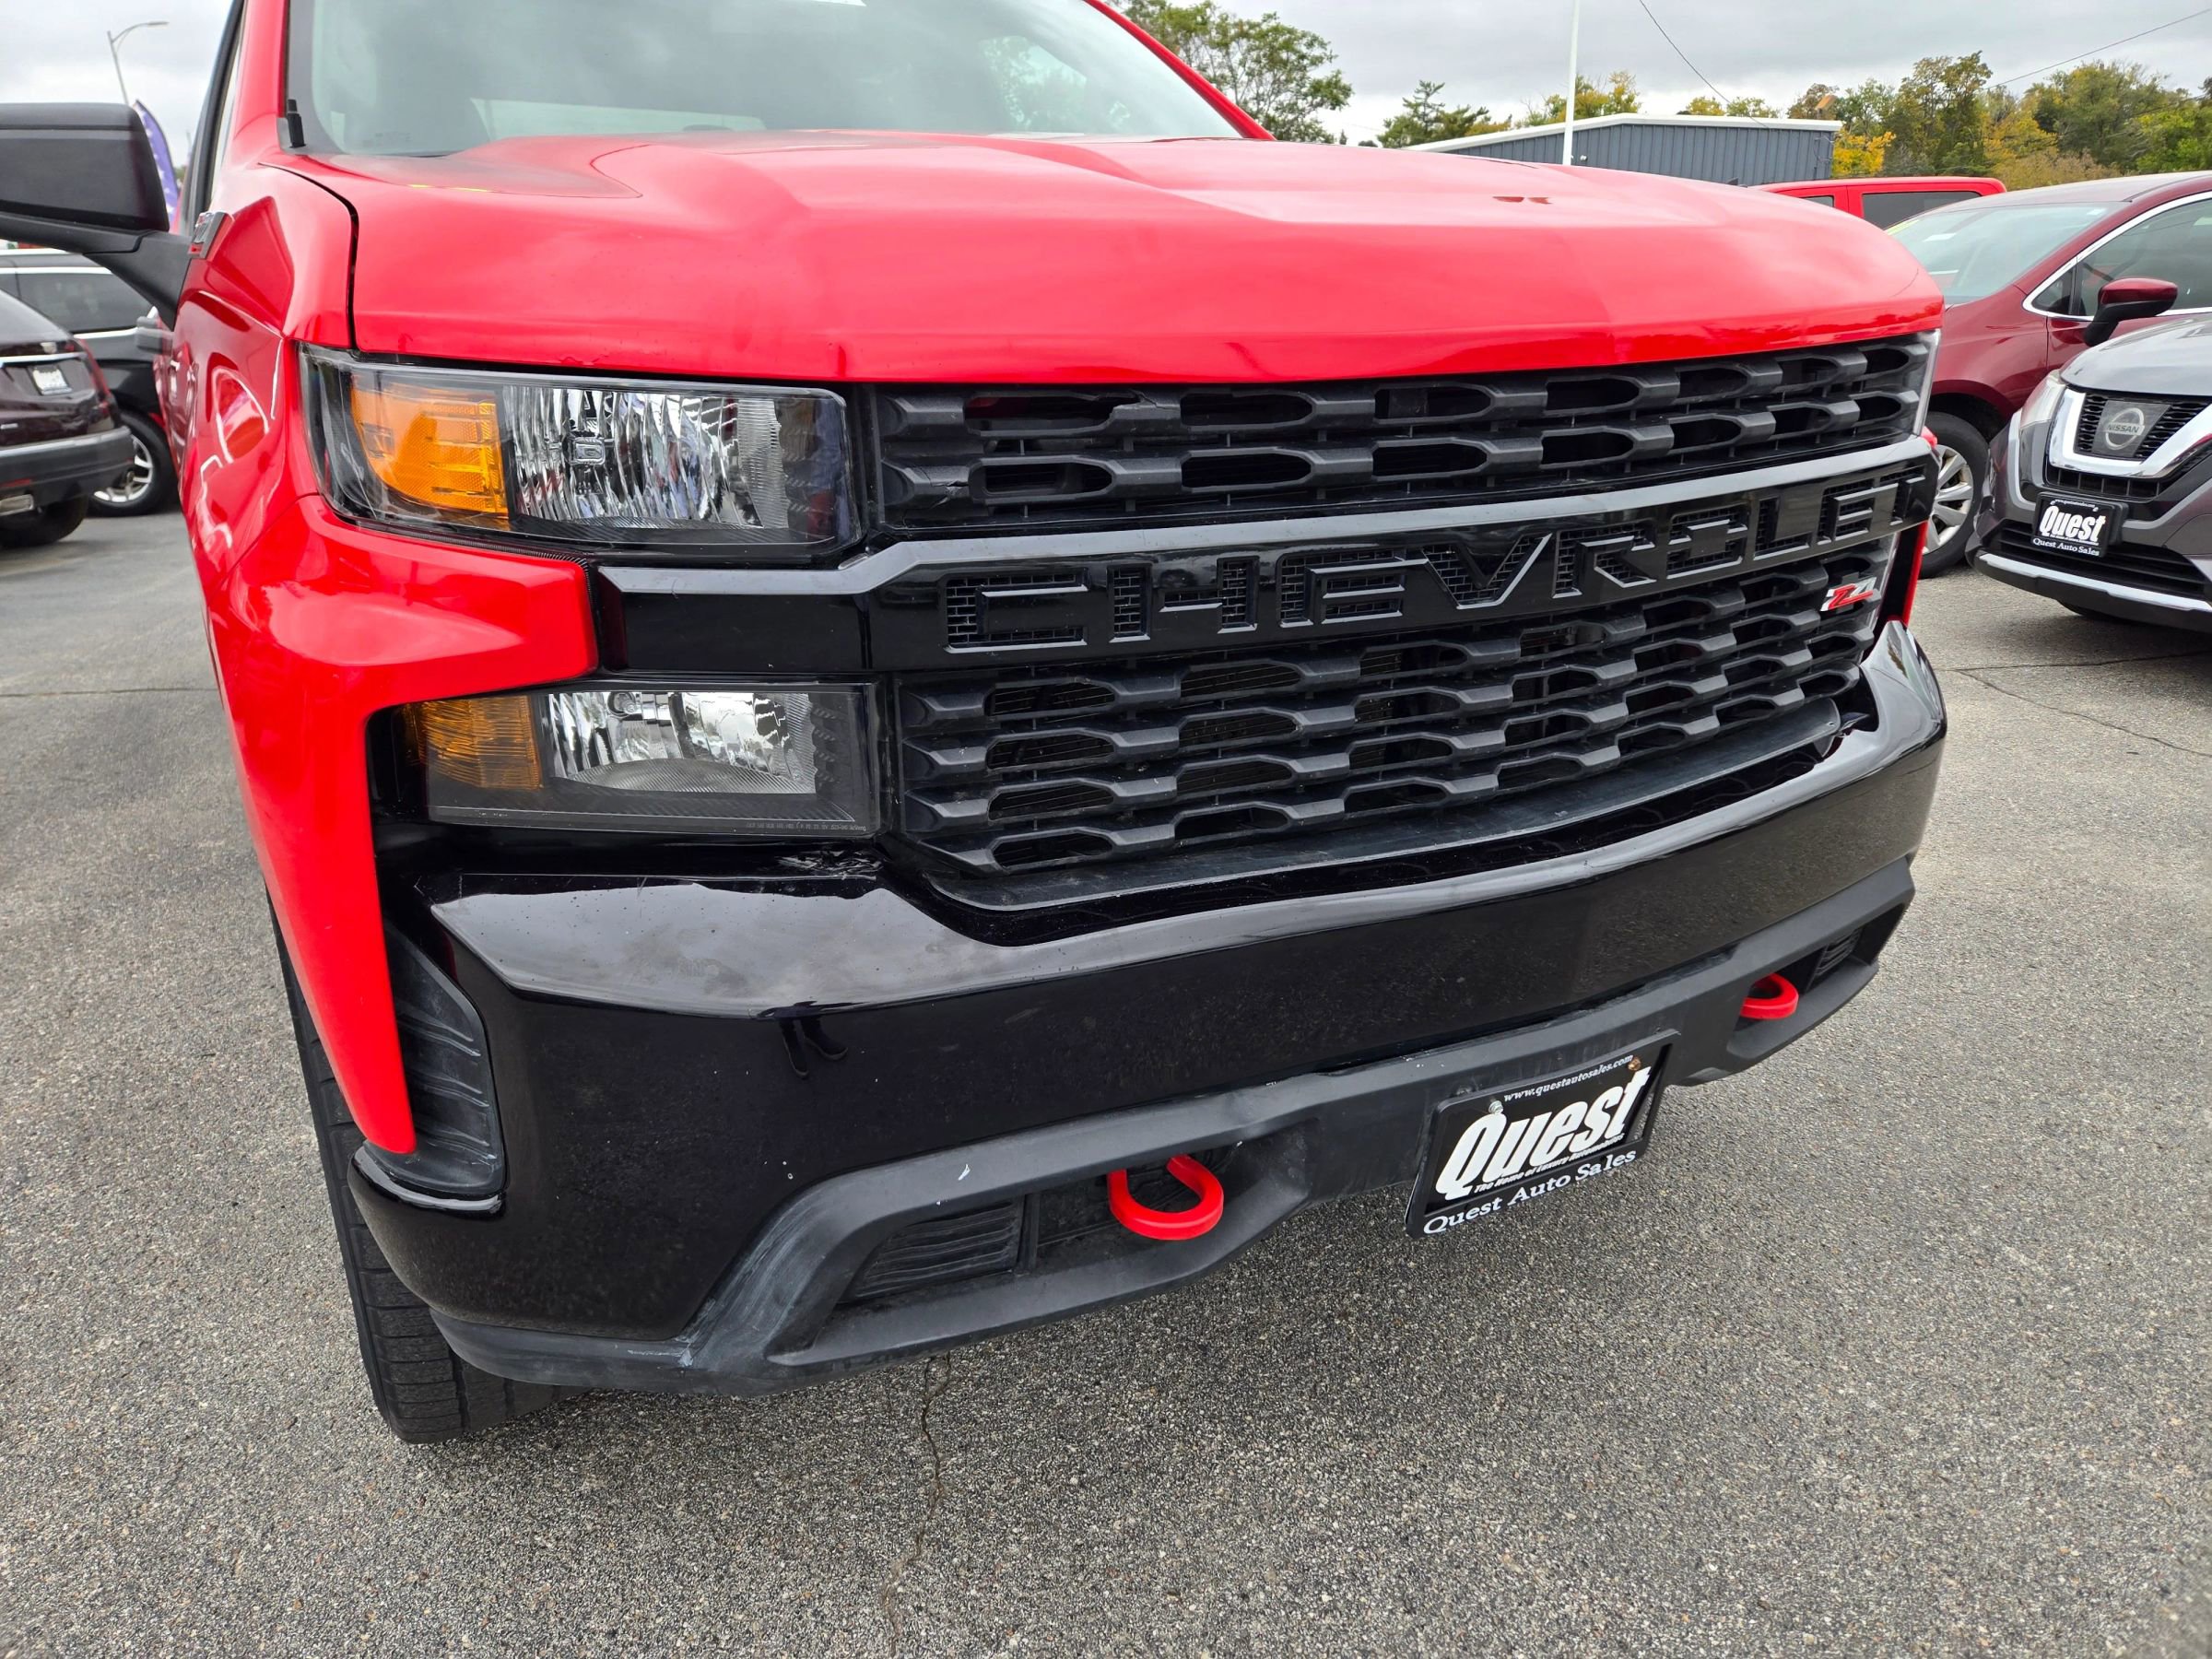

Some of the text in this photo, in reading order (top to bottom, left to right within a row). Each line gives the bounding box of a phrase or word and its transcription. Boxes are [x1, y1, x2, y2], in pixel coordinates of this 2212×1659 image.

[2107, 424, 2139, 433] NISSAN
[2032, 537, 2056, 548] Quest
[2057, 542, 2077, 552] Auto
[2077, 546, 2100, 557] Sales
[2039, 505, 2106, 542] Quest
[944, 464, 1926, 653] CHEVROLET
[1503, 1054, 1634, 1102] www.questautosales.com
[1434, 1065, 1651, 1201] Quest
[1423, 1149, 1637, 1235] Quest Auto Sales
